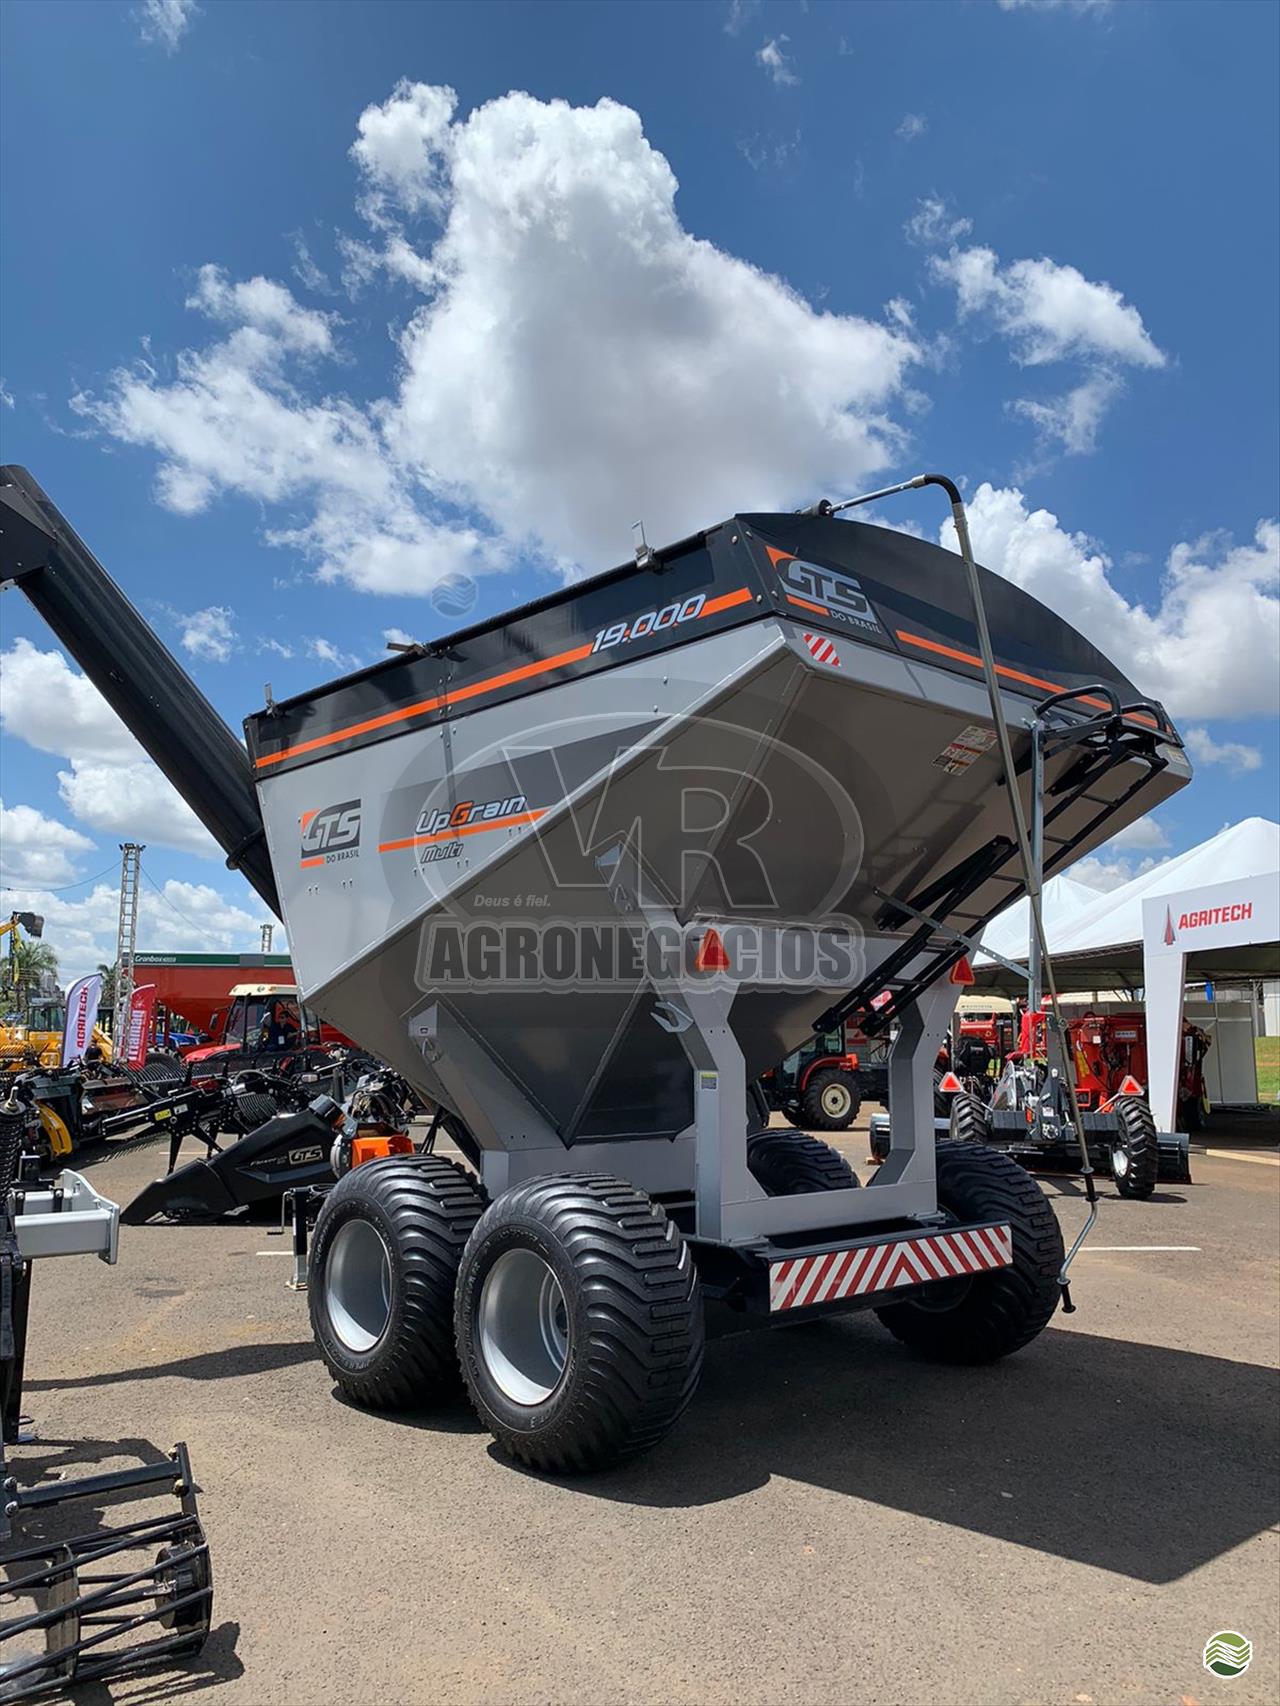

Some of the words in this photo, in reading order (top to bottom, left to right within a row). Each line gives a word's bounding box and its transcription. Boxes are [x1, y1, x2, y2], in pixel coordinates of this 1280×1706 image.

[778, 560, 872, 618] GTS
[592, 593, 706, 653] 19.000
[830, 609, 847, 622] DO
[847, 615, 882, 634] BRASIL
[302, 803, 361, 853] GTS
[415, 795, 527, 835] UpGrain
[326, 853, 337, 864] DO
[337, 848, 360, 861] BRASIL
[421, 841, 464, 863] Multi
[1178, 902, 1253, 930] AGRITECH
[76, 986, 89, 1049] AGRITECH
[289, 1146, 322, 1164] GTS
